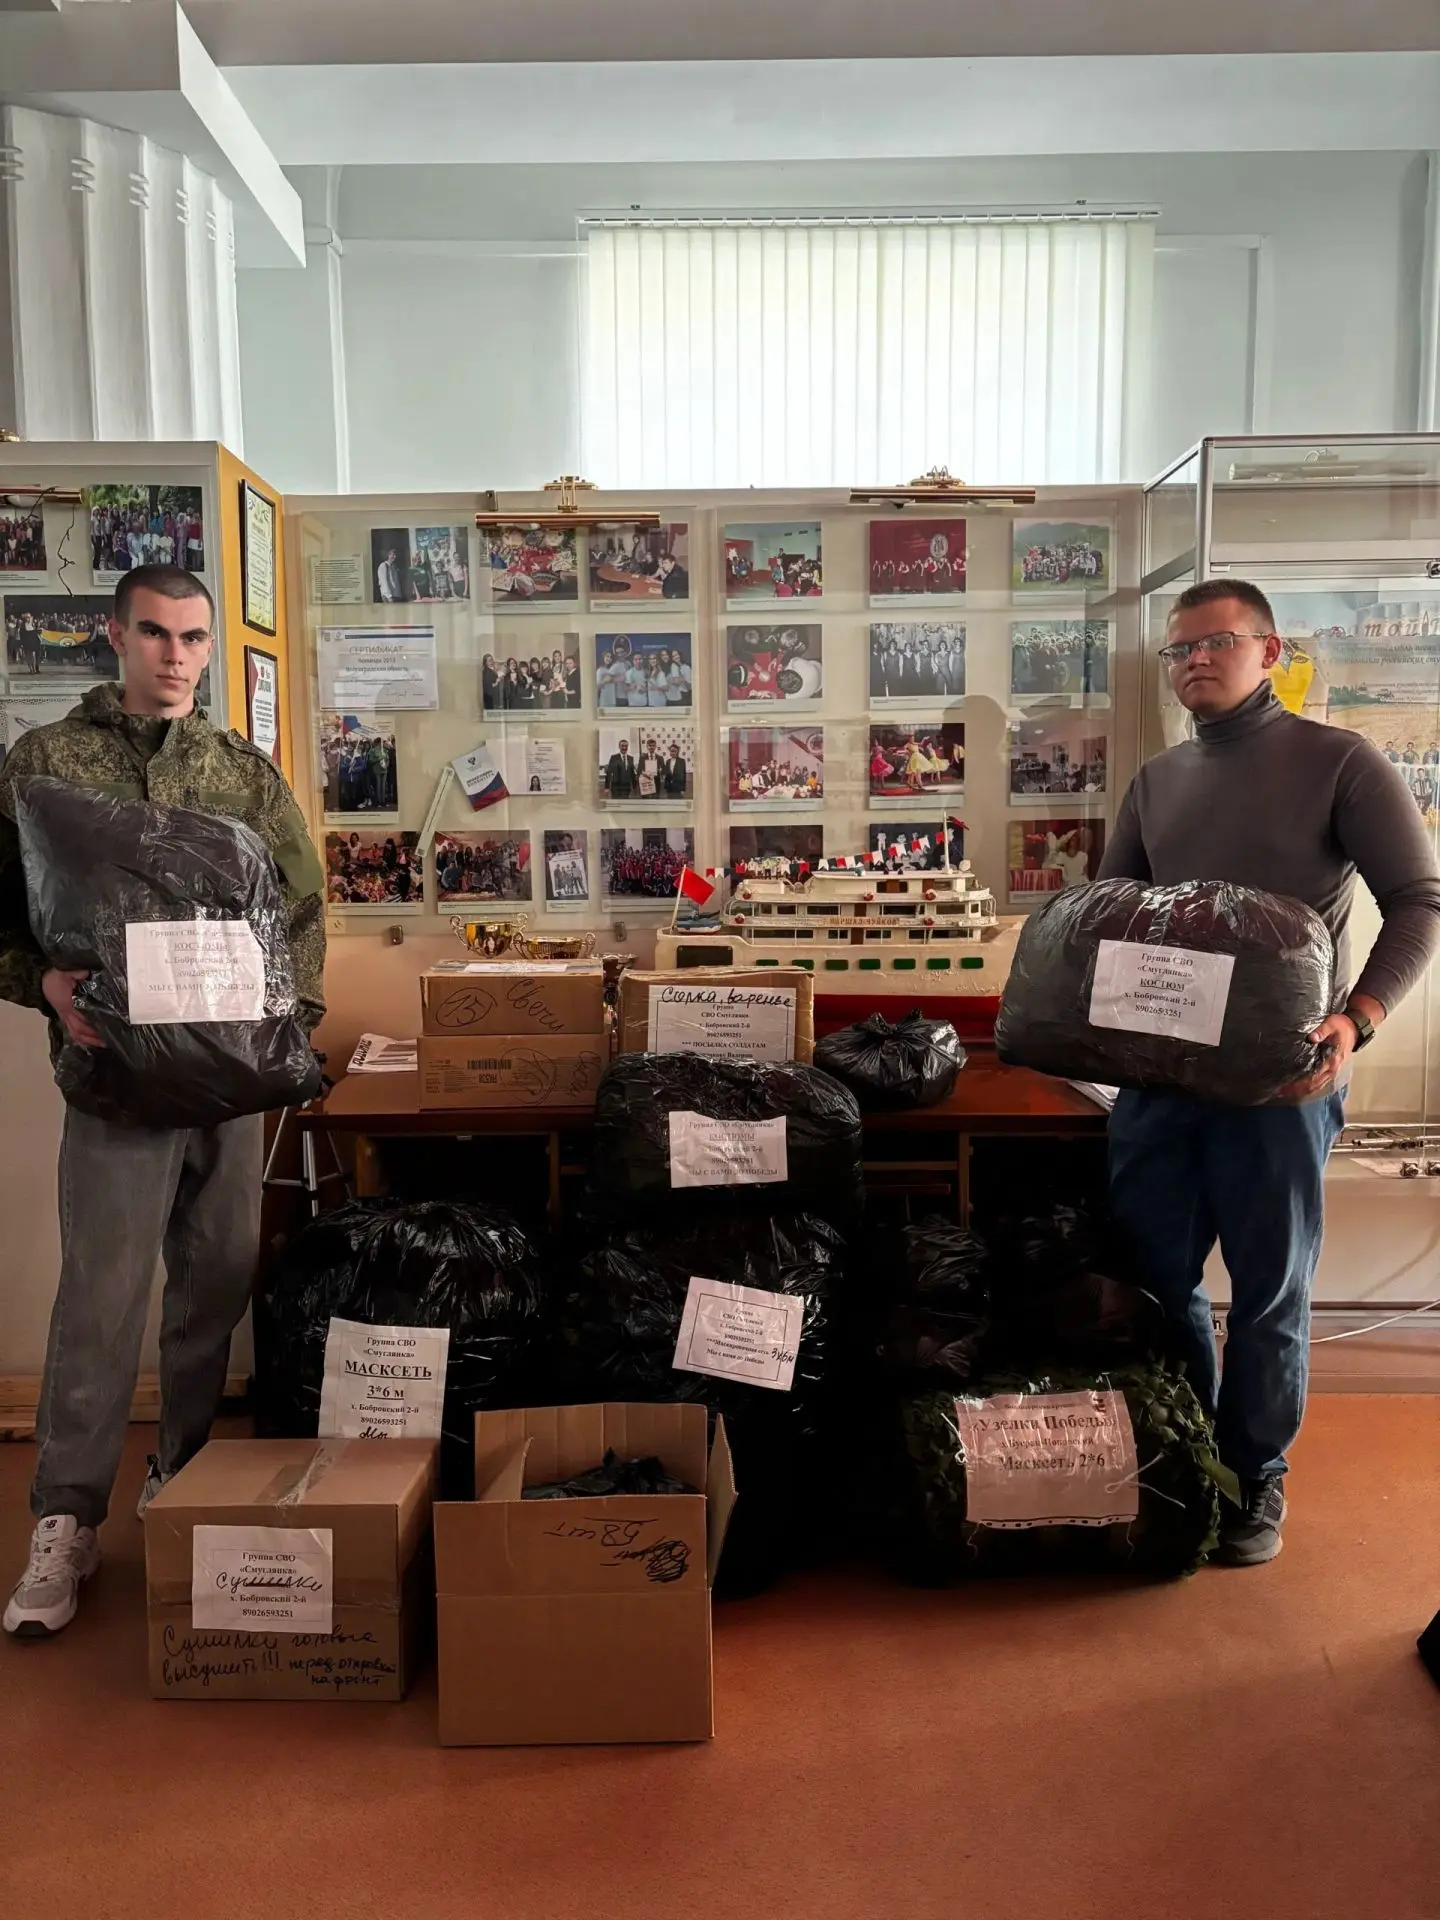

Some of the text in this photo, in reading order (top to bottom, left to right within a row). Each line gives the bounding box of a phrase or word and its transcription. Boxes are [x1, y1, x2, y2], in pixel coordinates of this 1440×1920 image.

[1141, 953, 1171, 964] Группа
[1140, 977, 1185, 991] КОСТЮМ
[367, 1337, 416, 1347] Группа СВО
[344, 1360, 433, 1378] МАСКСЕТЬ
[359, 1404, 405, 1413] Бобровский
[242, 1552, 296, 1562] Группа СВО
[239, 1595, 291, 1604] Бобровский
[242, 1609, 293, 1618] 89026593251
